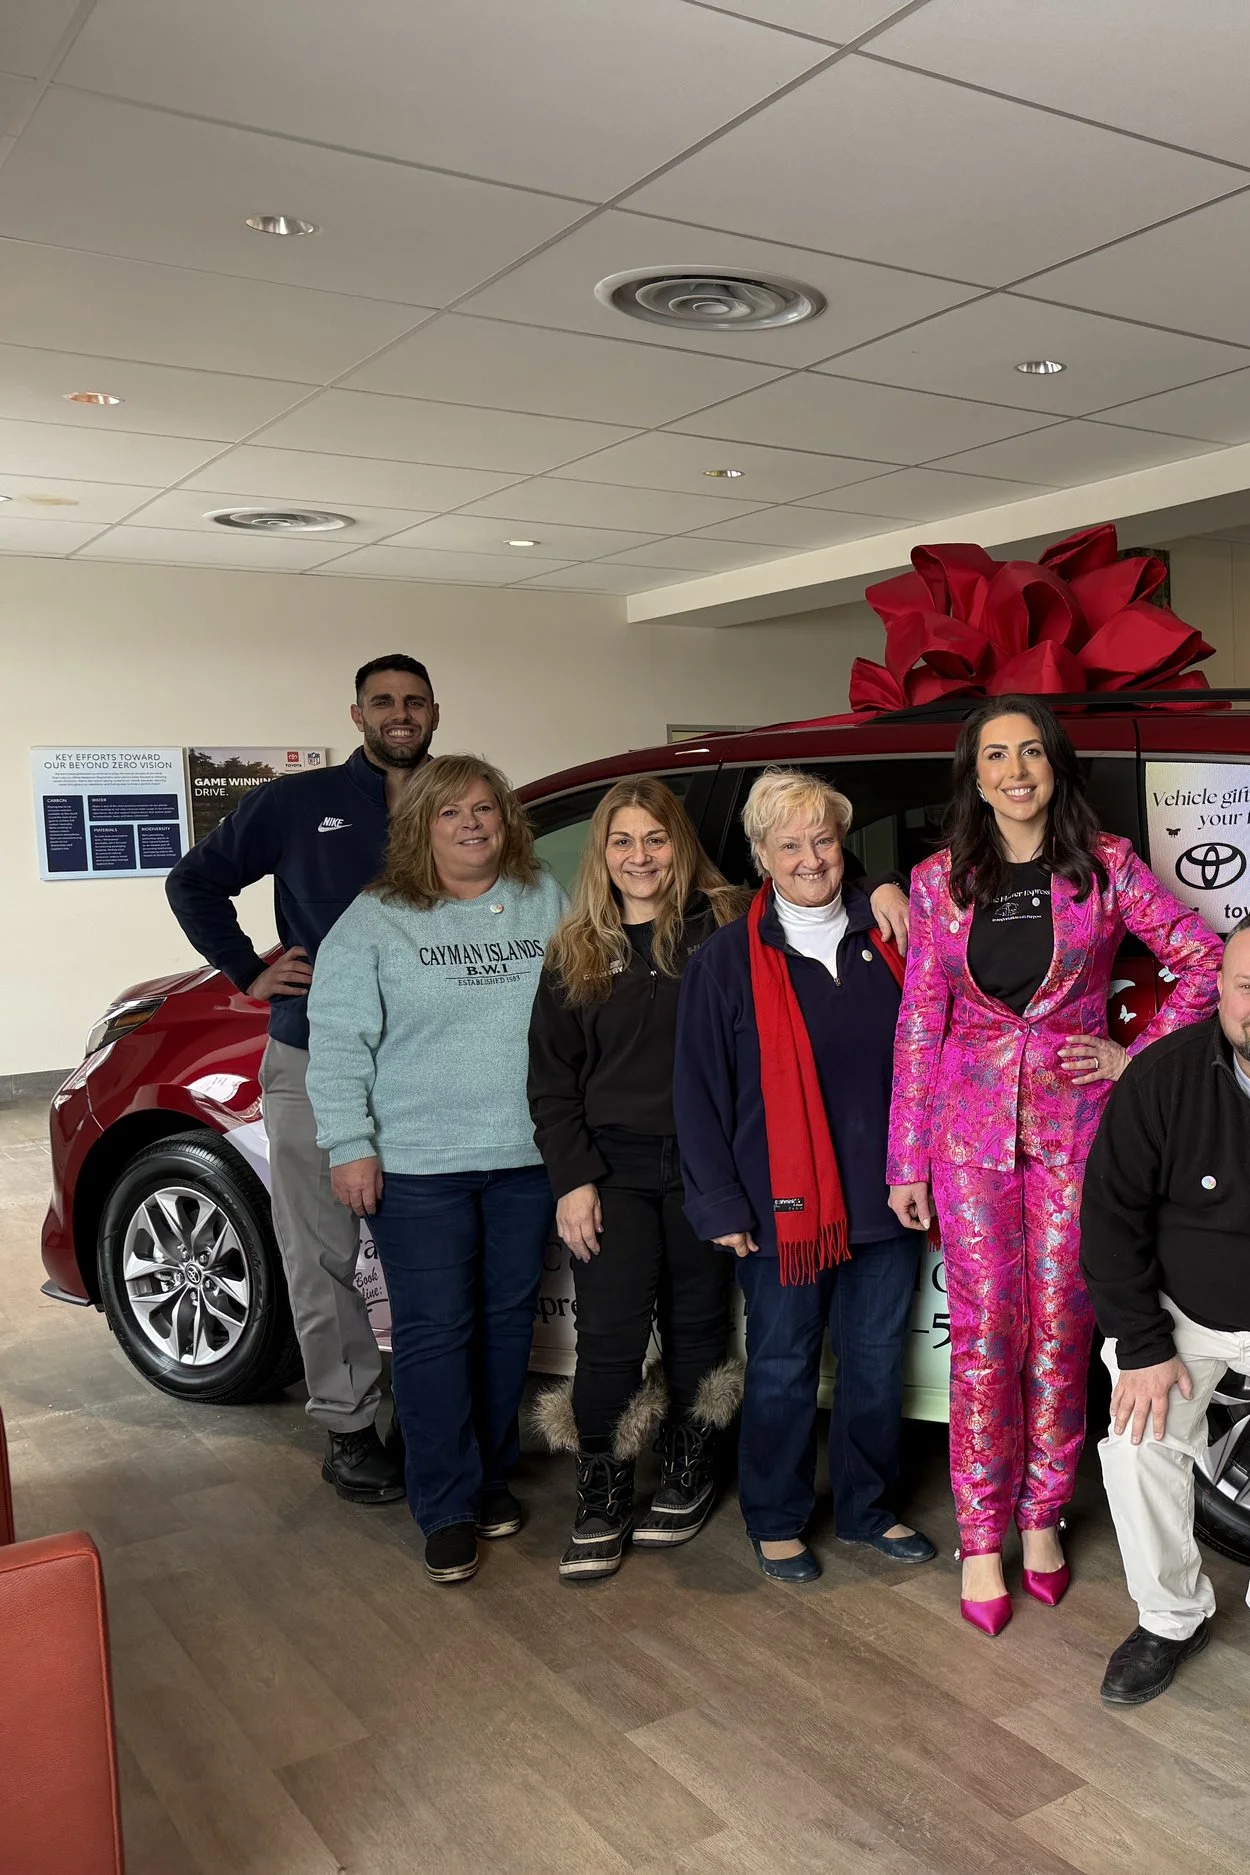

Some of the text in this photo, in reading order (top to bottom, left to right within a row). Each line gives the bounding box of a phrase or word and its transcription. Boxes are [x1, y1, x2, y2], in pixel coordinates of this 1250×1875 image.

[55, 753, 161, 761] KEY EFFORTS TOWARD
[44, 761, 172, 769] OUR BEYOND ZERO VISION
[194, 777, 278, 786] GAME WINNIN
[194, 788, 229, 797] DRIVE.
[1152, 788, 1218, 807] Vehicle
[322, 816, 345, 827] NIKE
[1197, 813, 1243, 830] your
[419, 940, 545, 966] CAYMAN ISLANDS
[458, 976, 505, 986] ESTABLISHED
[355, 1267, 379, 1288] Book
